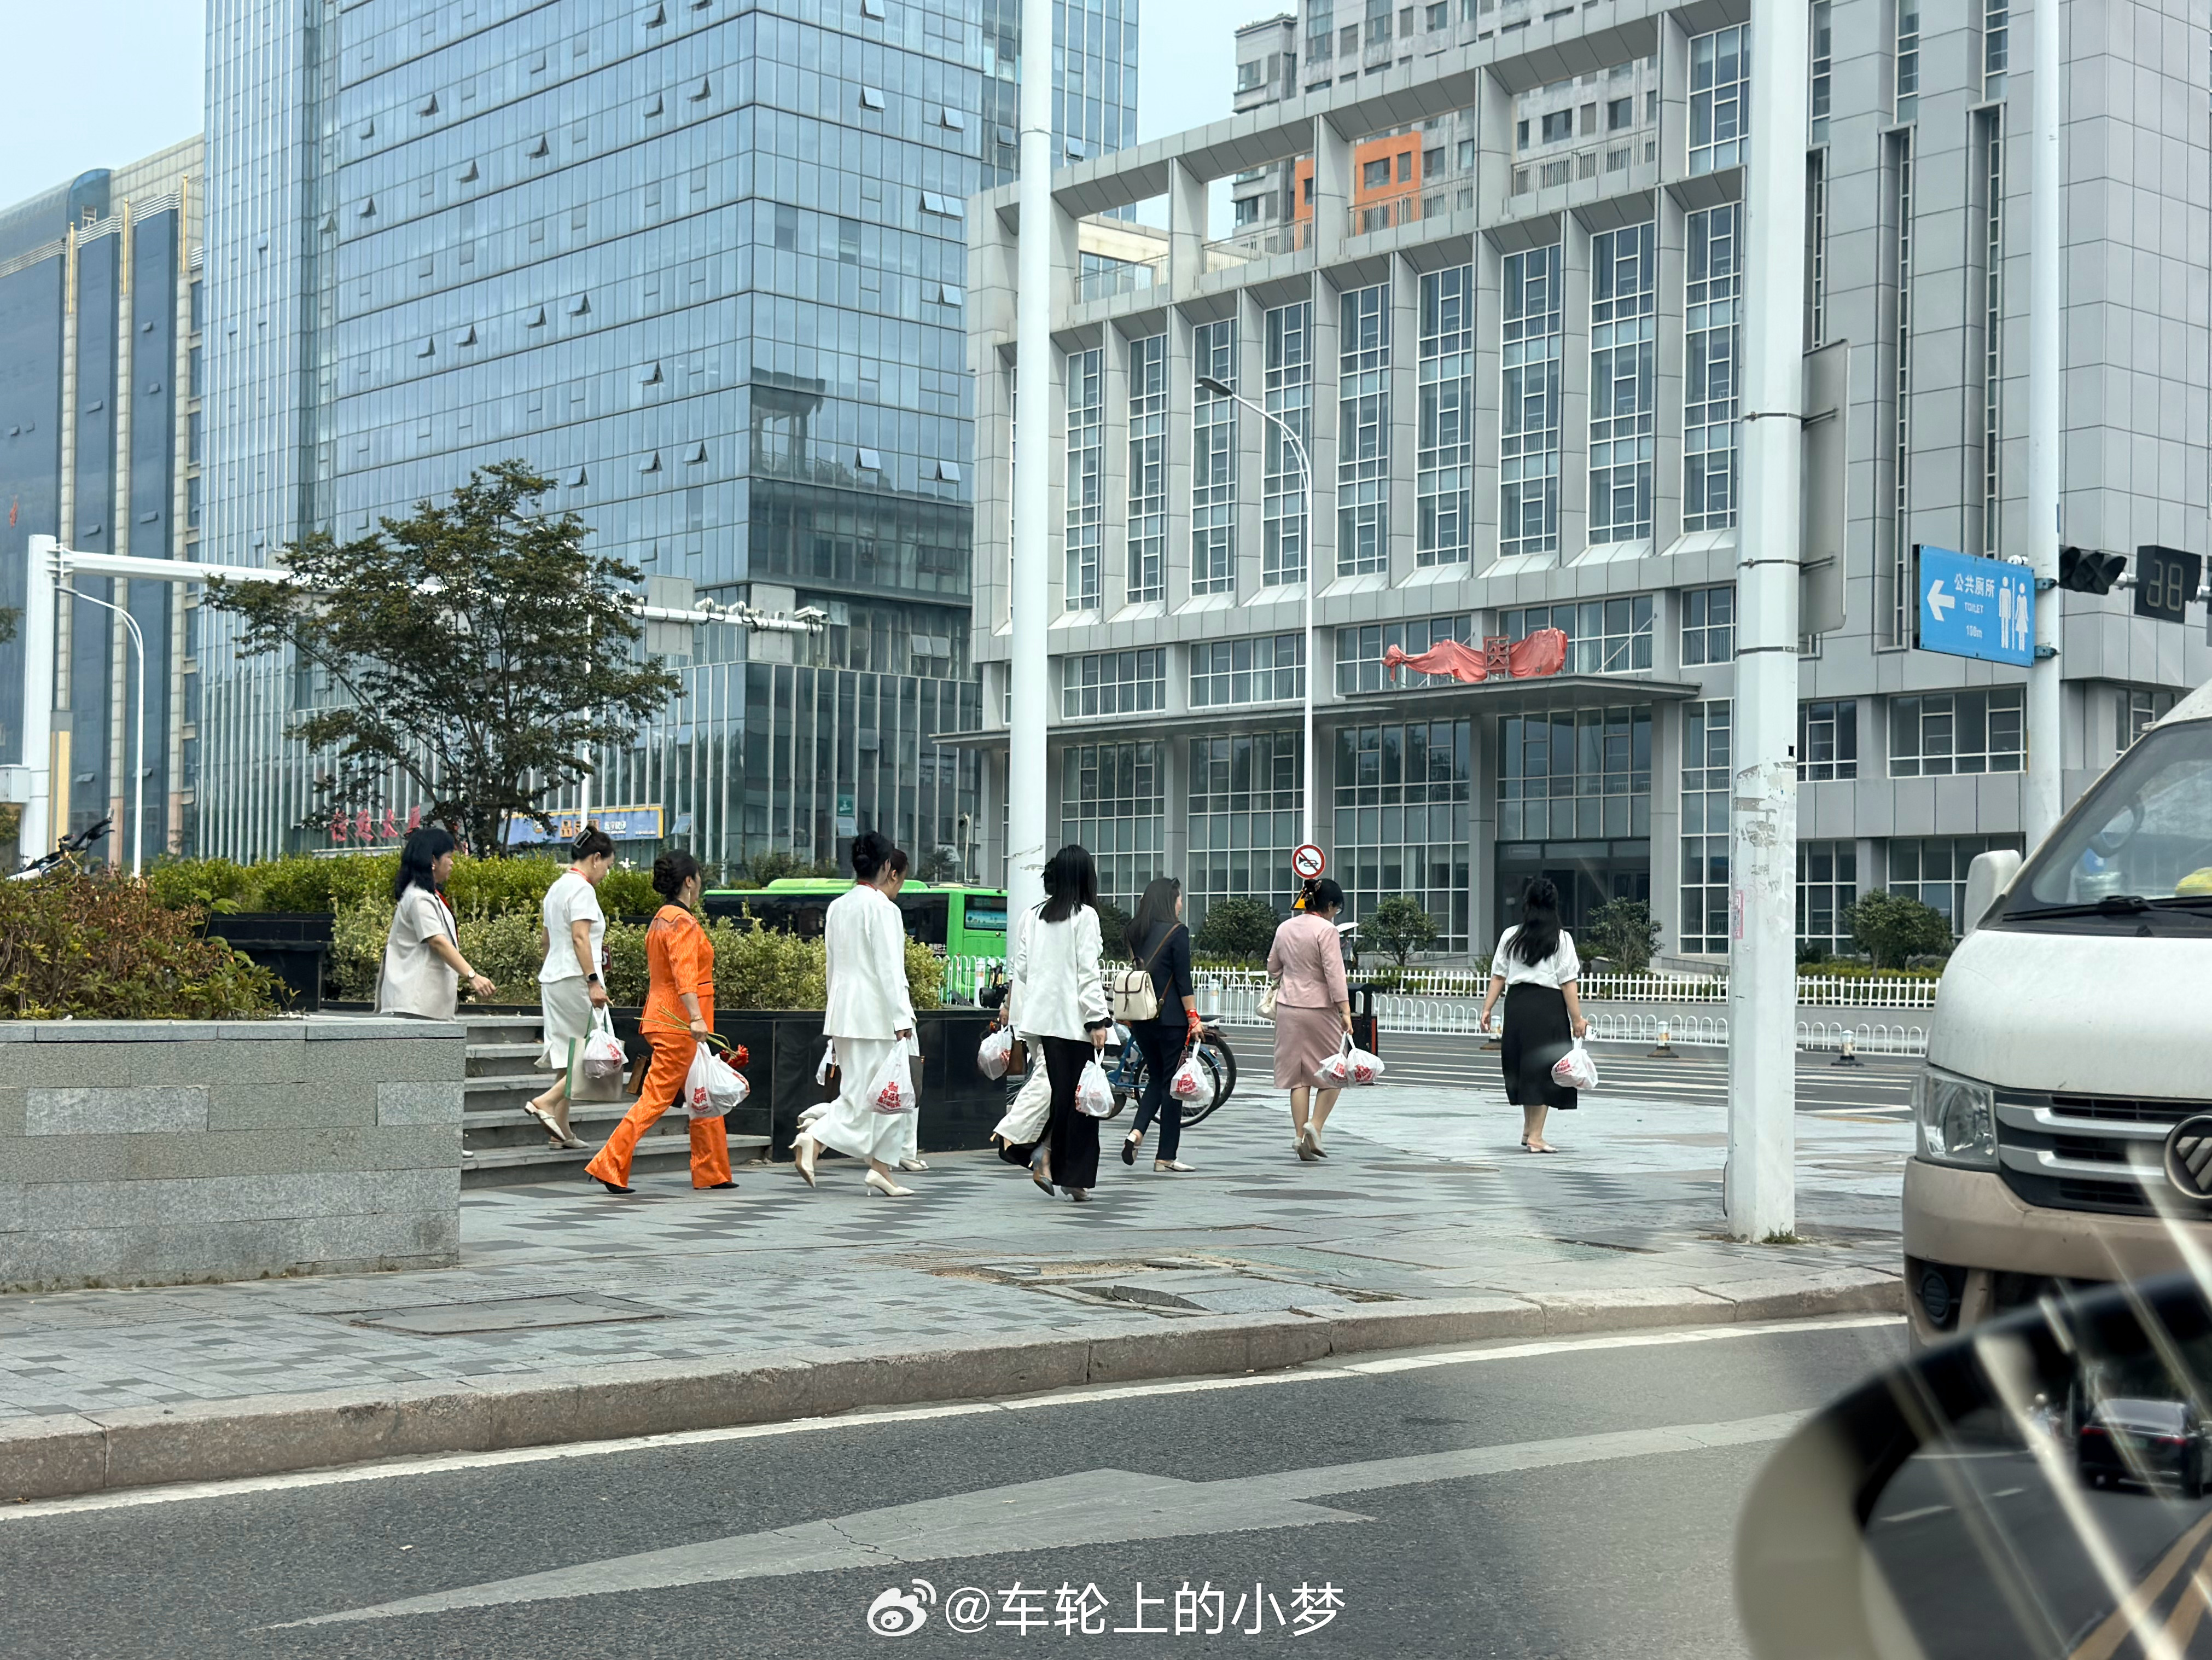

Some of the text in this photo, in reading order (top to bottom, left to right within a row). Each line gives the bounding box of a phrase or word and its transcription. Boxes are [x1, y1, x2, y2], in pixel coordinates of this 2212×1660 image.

[1954, 573, 1995, 599] 公共厕所
[1965, 602, 1983, 614] TOILET
